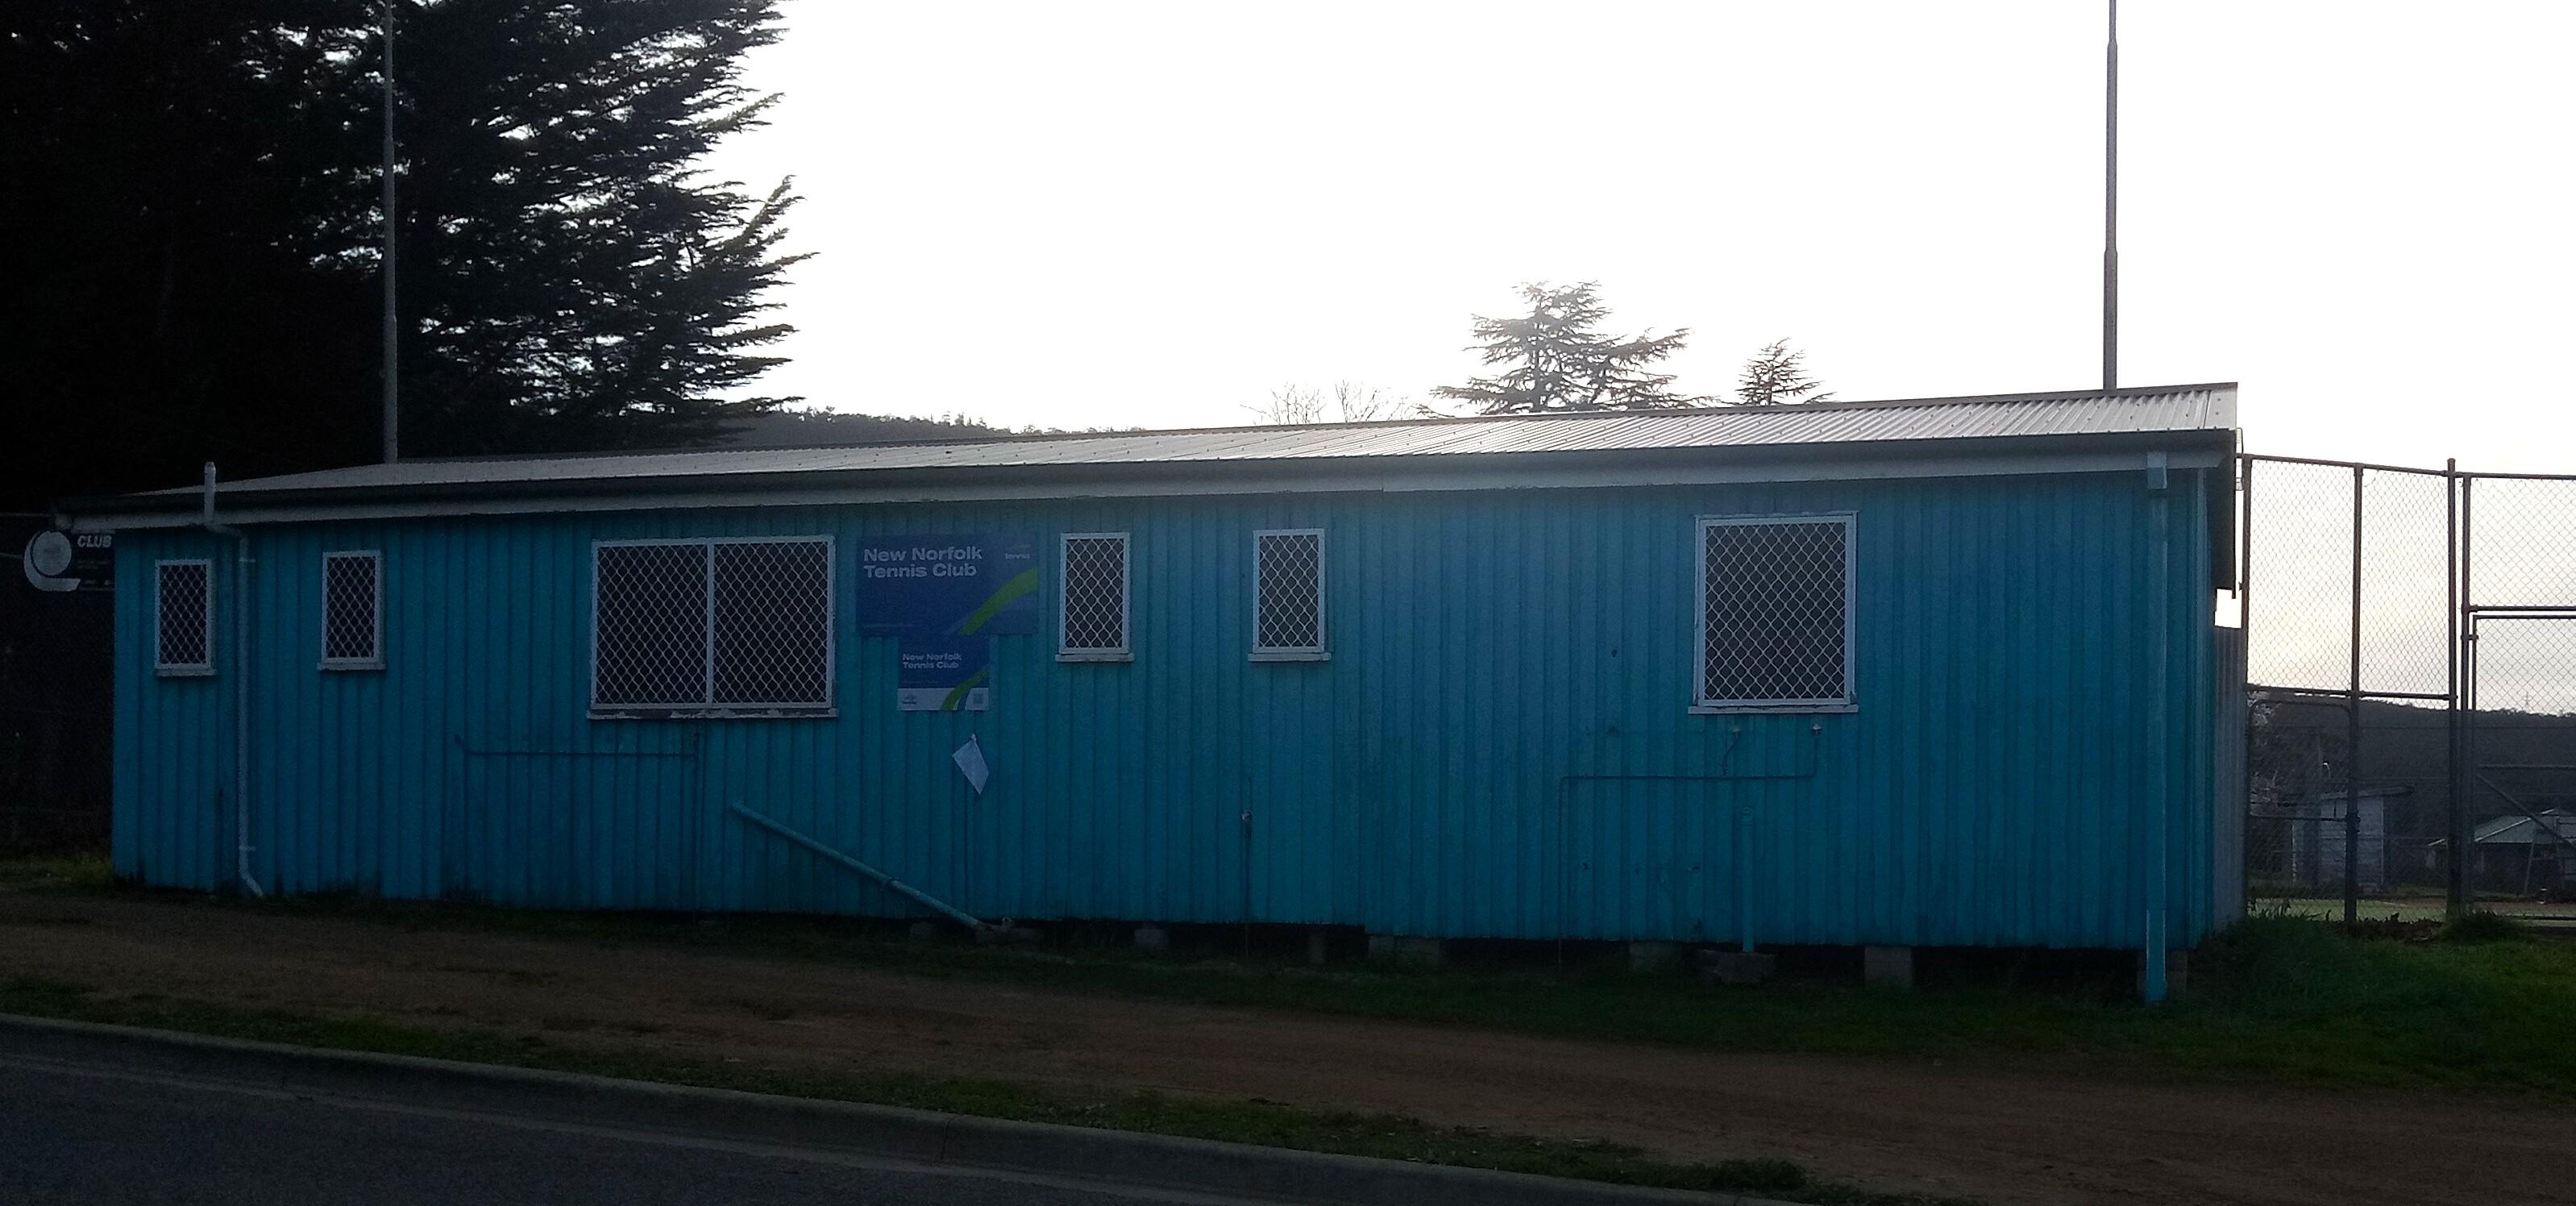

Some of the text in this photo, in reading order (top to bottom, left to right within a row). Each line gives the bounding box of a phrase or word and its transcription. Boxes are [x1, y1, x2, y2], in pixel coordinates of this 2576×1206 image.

[77, 535, 112, 548] CLUB
[863, 546, 983, 562] New Norfolk
[863, 563, 978, 578] Tennis Club
[902, 652, 962, 661] New Norfolk
[902, 661, 959, 669] Tennis Club
